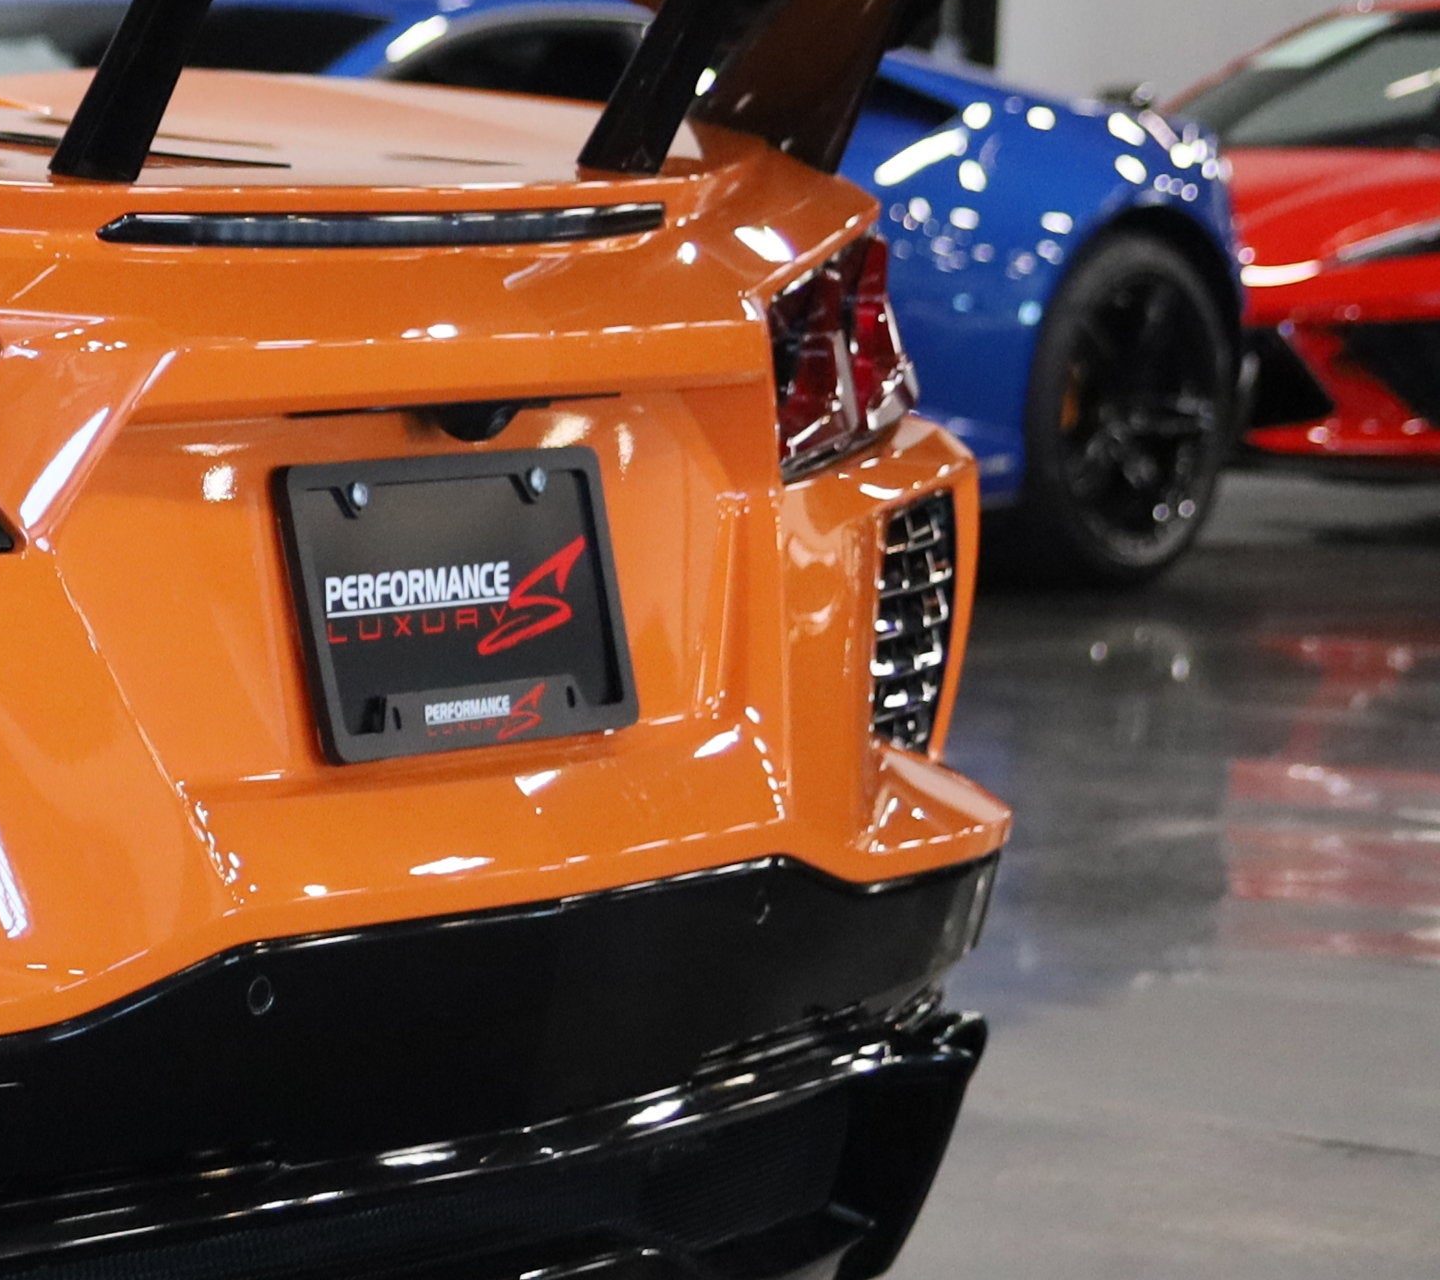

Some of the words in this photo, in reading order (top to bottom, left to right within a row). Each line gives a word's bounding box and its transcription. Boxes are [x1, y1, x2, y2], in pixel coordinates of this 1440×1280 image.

[325, 561, 509, 612] PERFORMANCE
[327, 604, 508, 644] LUXURY
[425, 695, 510, 722] PERFORMANCE
